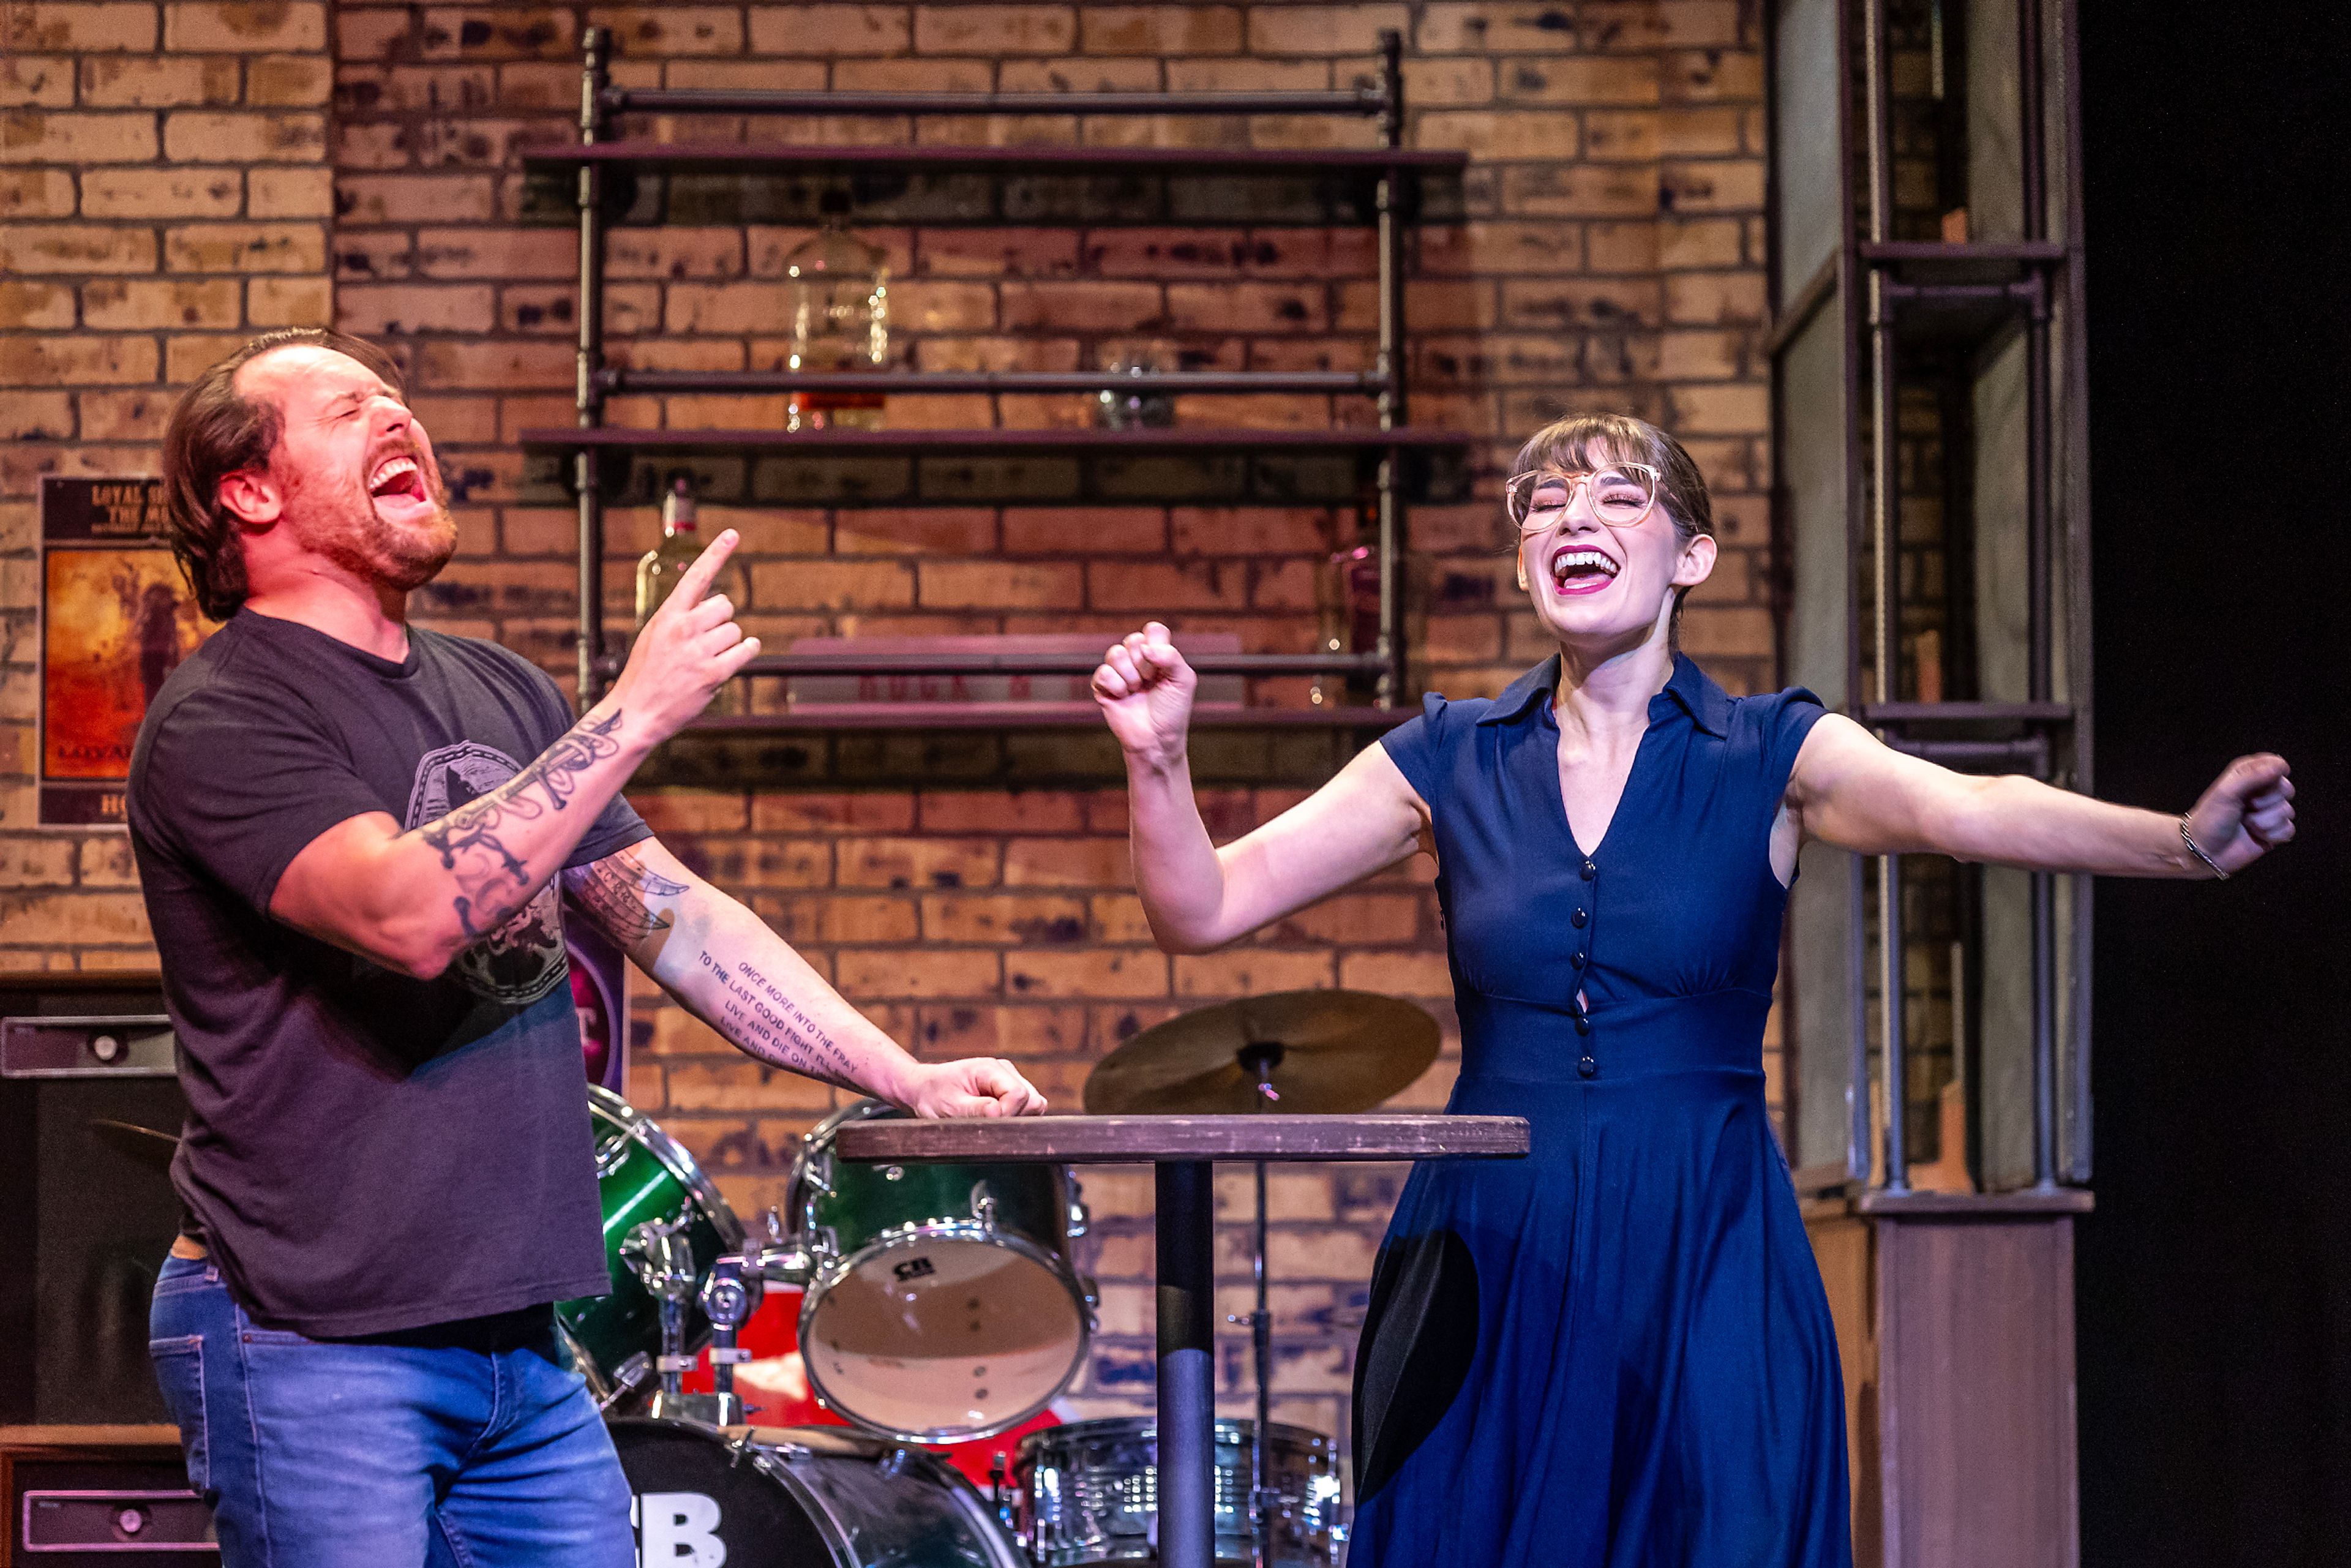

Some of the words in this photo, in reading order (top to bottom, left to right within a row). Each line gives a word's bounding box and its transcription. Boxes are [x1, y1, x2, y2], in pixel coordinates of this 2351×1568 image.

[699, 950, 712, 966] TO
[711, 962, 730, 984] THE
[729, 980, 756, 1005] LAST
[755, 1002, 784, 1030] GOOD
[785, 1027, 814, 1055] FIGHT
[725, 1000, 745, 1021] LIVE
[748, 1021, 770, 1040] AND
[772, 1037, 790, 1054] DIE
[791, 1053, 807, 1068] ON
[738, 962, 767, 988] ONCE
[765, 985, 795, 1013] MORE
[793, 1010, 816, 1033] INTO
[816, 1030, 834, 1051] THE
[833, 1048, 858, 1073] FRAY
[743, 1036, 765, 1056] AND
[629, 1491, 727, 1568] B
